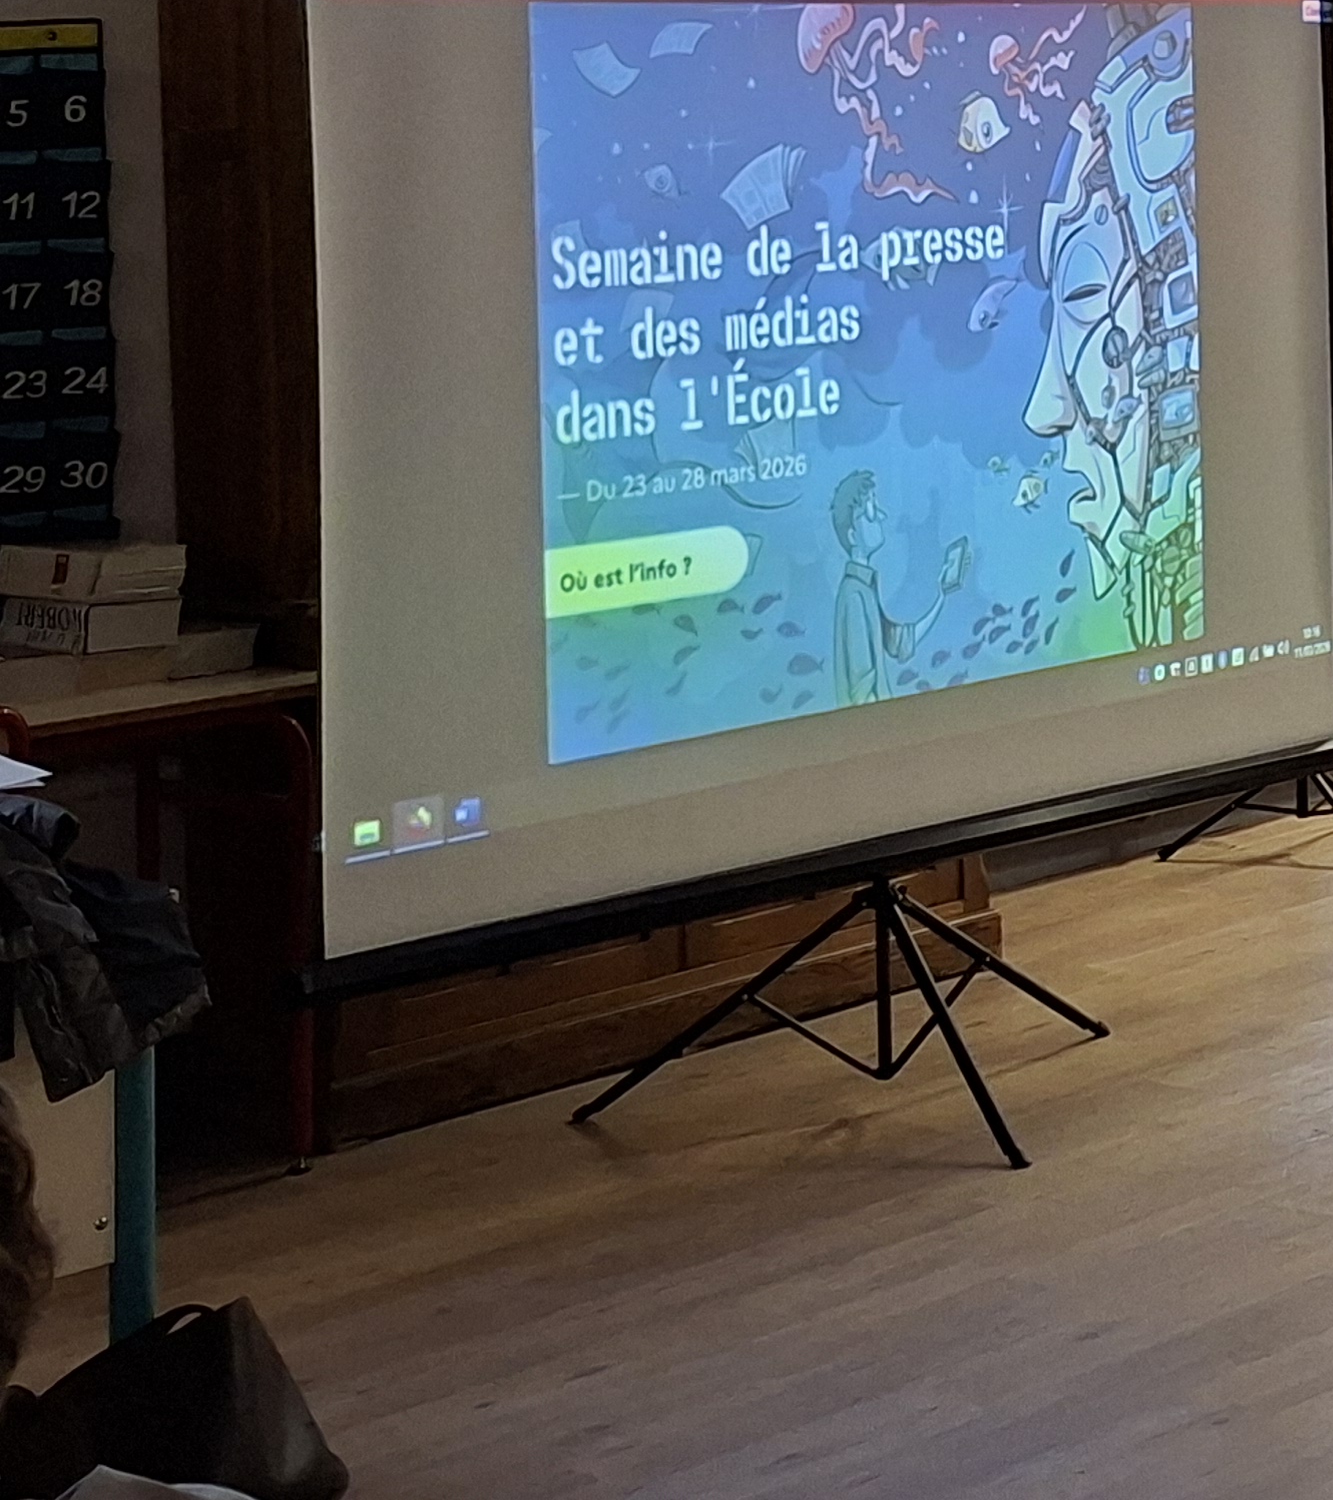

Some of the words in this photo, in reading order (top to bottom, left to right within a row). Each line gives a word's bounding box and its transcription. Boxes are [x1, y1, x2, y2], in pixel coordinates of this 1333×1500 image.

[5, 99, 29, 128] 5
[63, 95, 87, 124] 6
[3, 192, 37, 221] 11
[61, 190, 102, 220] 12
[551, 230, 723, 290] Semaine
[747, 224, 792, 277] de
[815, 221, 859, 272] la
[881, 225, 1004, 281] presse
[2, 282, 42, 311] 17
[63, 278, 103, 308] 18
[554, 317, 604, 367] et
[631, 306, 701, 361] des
[725, 294, 860, 351] médias
[2, 369, 48, 400] 23
[61, 366, 110, 395] 24
[556, 389, 656, 445] dans
[680, 357, 840, 431] l'École
[0, 465, 47, 494] 29
[60, 460, 108, 490] 30
[587, 479, 616, 502] Du
[622, 475, 647, 498] 23
[652, 476, 676, 494] au
[682, 467, 705, 490] 28
[711, 466, 755, 486] mars
[761, 454, 806, 480] 2026
[560, 570, 587, 593] Où
[594, 569, 623, 588] est
[683, 556, 692, 576] ?
